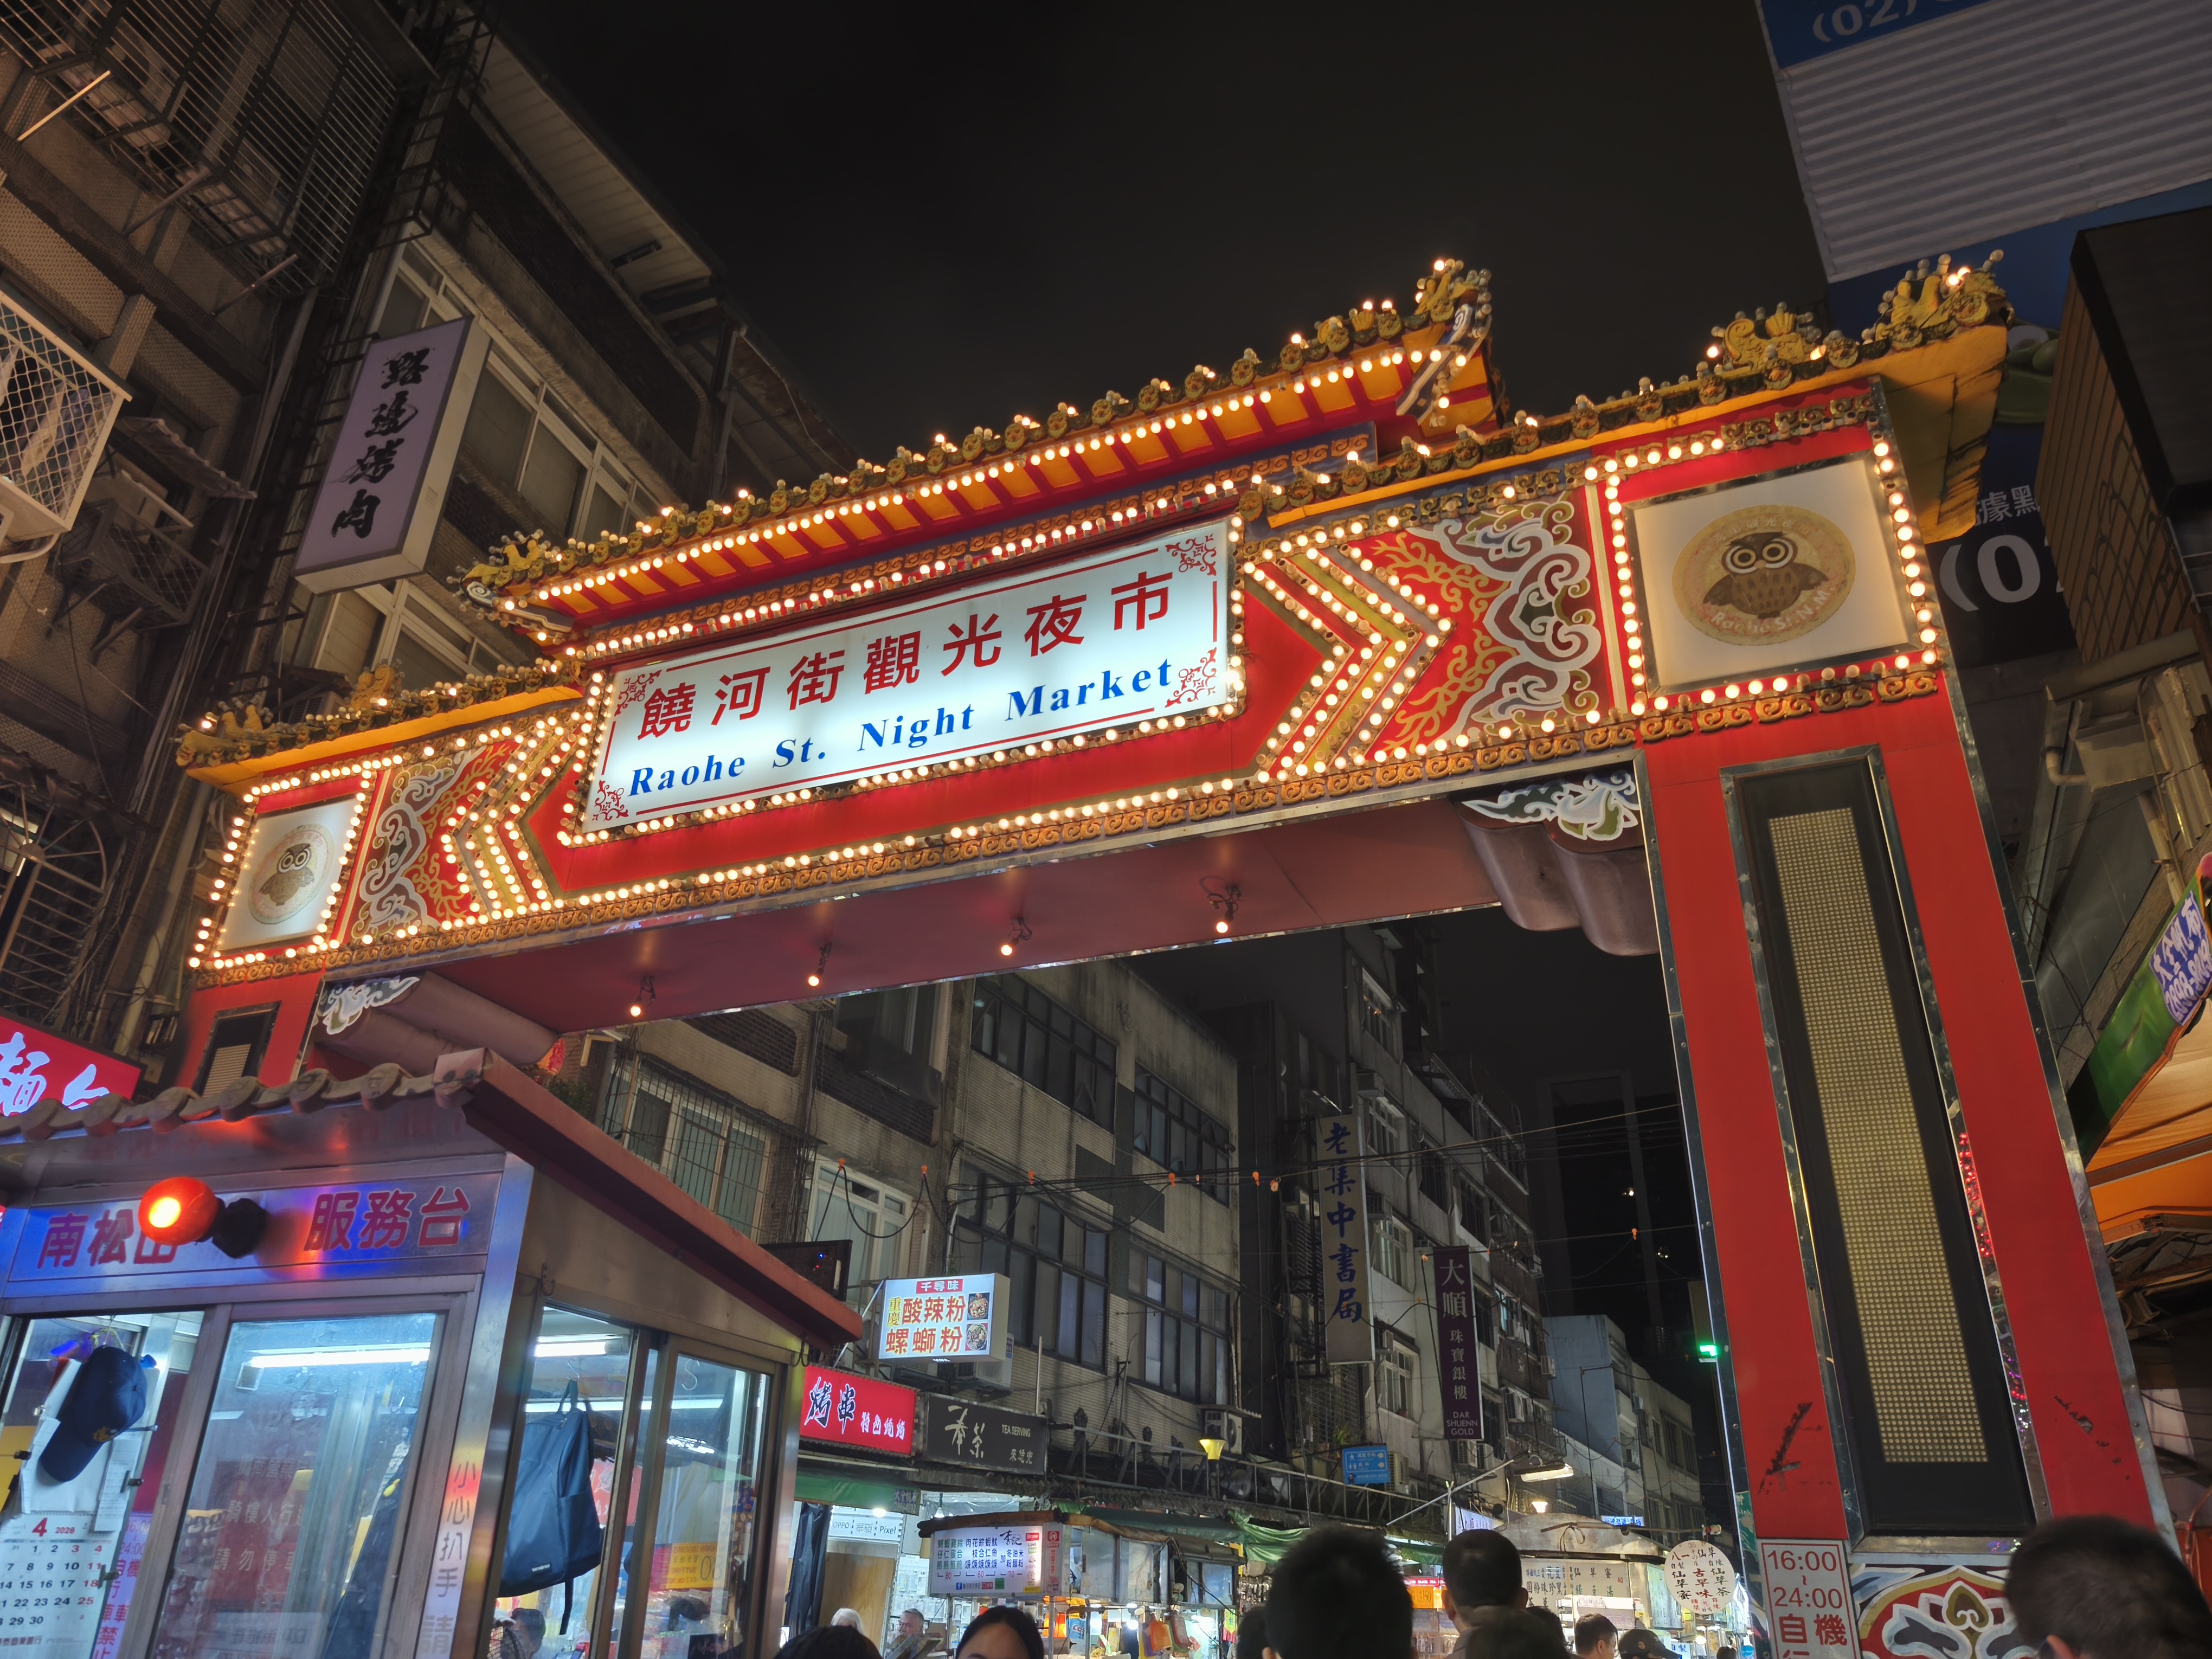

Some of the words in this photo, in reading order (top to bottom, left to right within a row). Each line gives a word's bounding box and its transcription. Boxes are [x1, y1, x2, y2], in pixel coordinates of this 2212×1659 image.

[636, 569, 1176, 742] 饒河街觀光夜市
[627, 753, 745, 797] Raohe
[771, 736, 826, 769] St.
[857, 701, 975, 753] Night
[1007, 657, 1173, 721] Market
[303, 1185, 471, 1252] 服務台
[1323, 1121, 1362, 1324] 老集中書局
[921, 1280, 960, 1293] 千尋味
[886, 1296, 902, 1327] 重慶
[902, 1295, 966, 1325] 酸辣粉
[885, 1326, 963, 1354] 螺螄粉
[803, 1376, 856, 1435] 烤串
[1453, 1411, 1470, 1419] DAR
[1001, 1424, 1011, 1435] TEA
[1011, 1426, 1031, 1437] SERVING
[1451, 1427, 1474, 1436] GOLD
[31, 1517, 48, 1537] 4
[435, 1461, 476, 1598] 小心扒手
[879, 1525, 896, 1534] Pixel
[1000, 1529, 1023, 1546] 李記
[1671, 1551, 1690, 1560] 八一
[1767, 1549, 1837, 1571] 16:00
[47, 1562, 54, 1570] 9
[65, 1562, 80, 1570] 10
[978, 1570, 984, 1578] 60
[20, 1580, 33, 1589] 15
[40, 1580, 53, 1588] 16
[60, 1579, 75, 1587] 17
[1693, 1568, 1713, 1599] 古早味
[14, 1599, 29, 1607] 22
[34, 1598, 48, 1606] 23
[54, 1597, 70, 1606] 24
[77, 1597, 94, 1605] 25
[1773, 1586, 1843, 1609] 24:00
[9, 1617, 24, 1625] 29
[29, 1616, 44, 1625] 30
